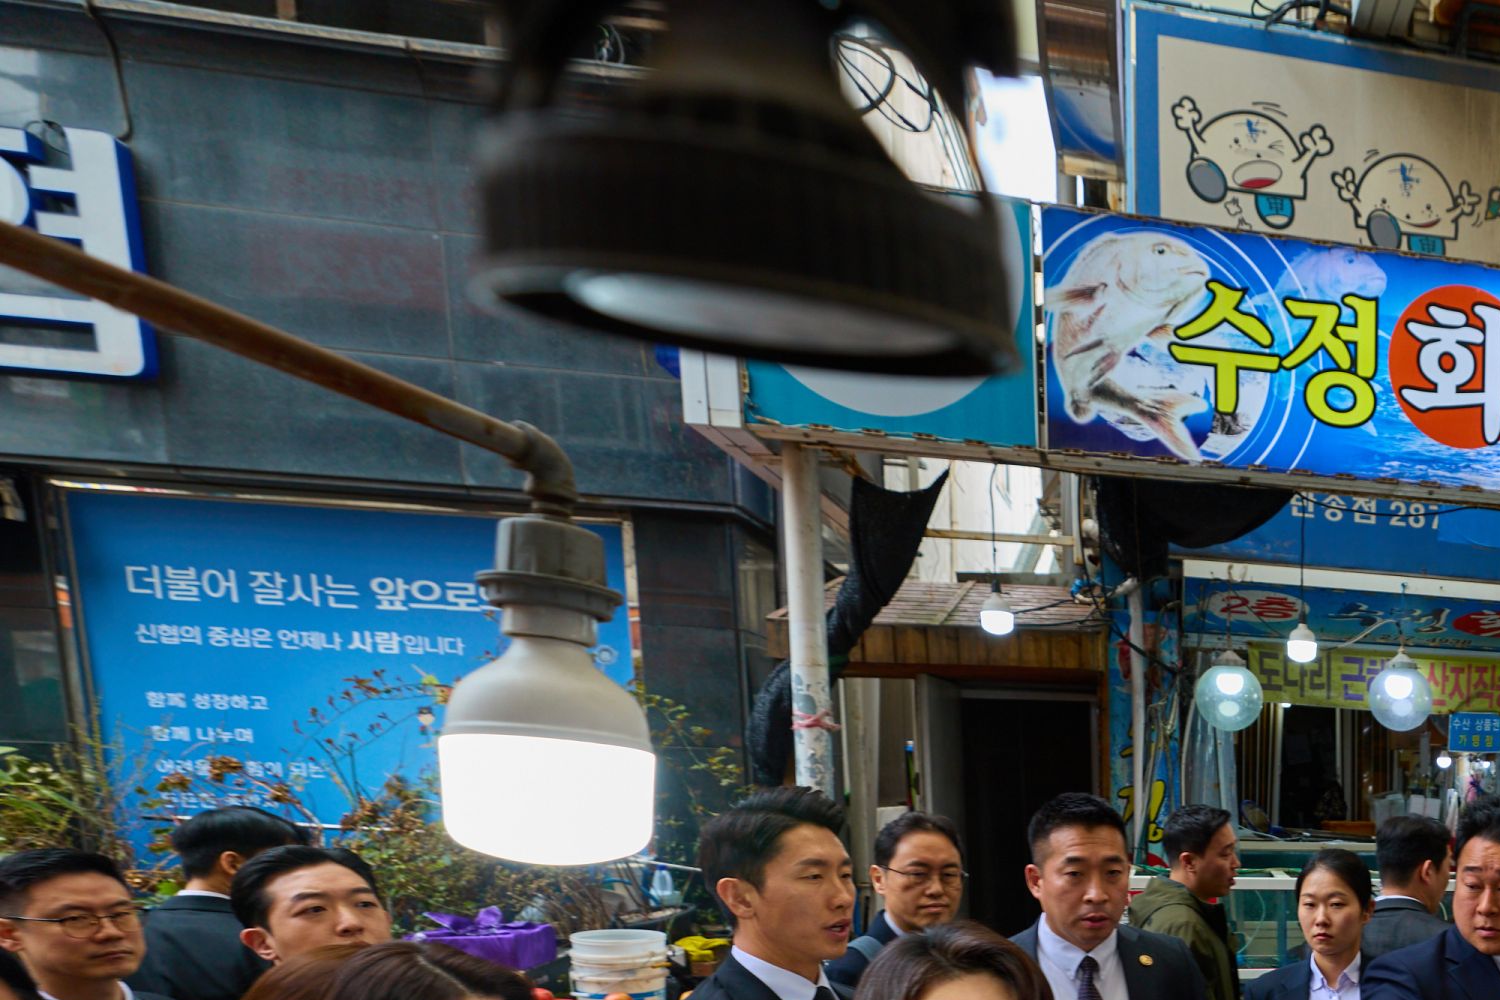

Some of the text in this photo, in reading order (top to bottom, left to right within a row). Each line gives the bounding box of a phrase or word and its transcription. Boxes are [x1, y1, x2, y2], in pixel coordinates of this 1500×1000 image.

[125, 564, 239, 603] 더불어
[248, 569, 360, 610] 잘사는
[1221, 594, 1299, 620] 2층
[135, 623, 465, 657] 신협의 중심은 언제나 사람입니다
[145, 691, 269, 711] 함께 성장하고
[196, 727, 255, 744] 나누며
[1453, 718, 1470, 731] 수산
